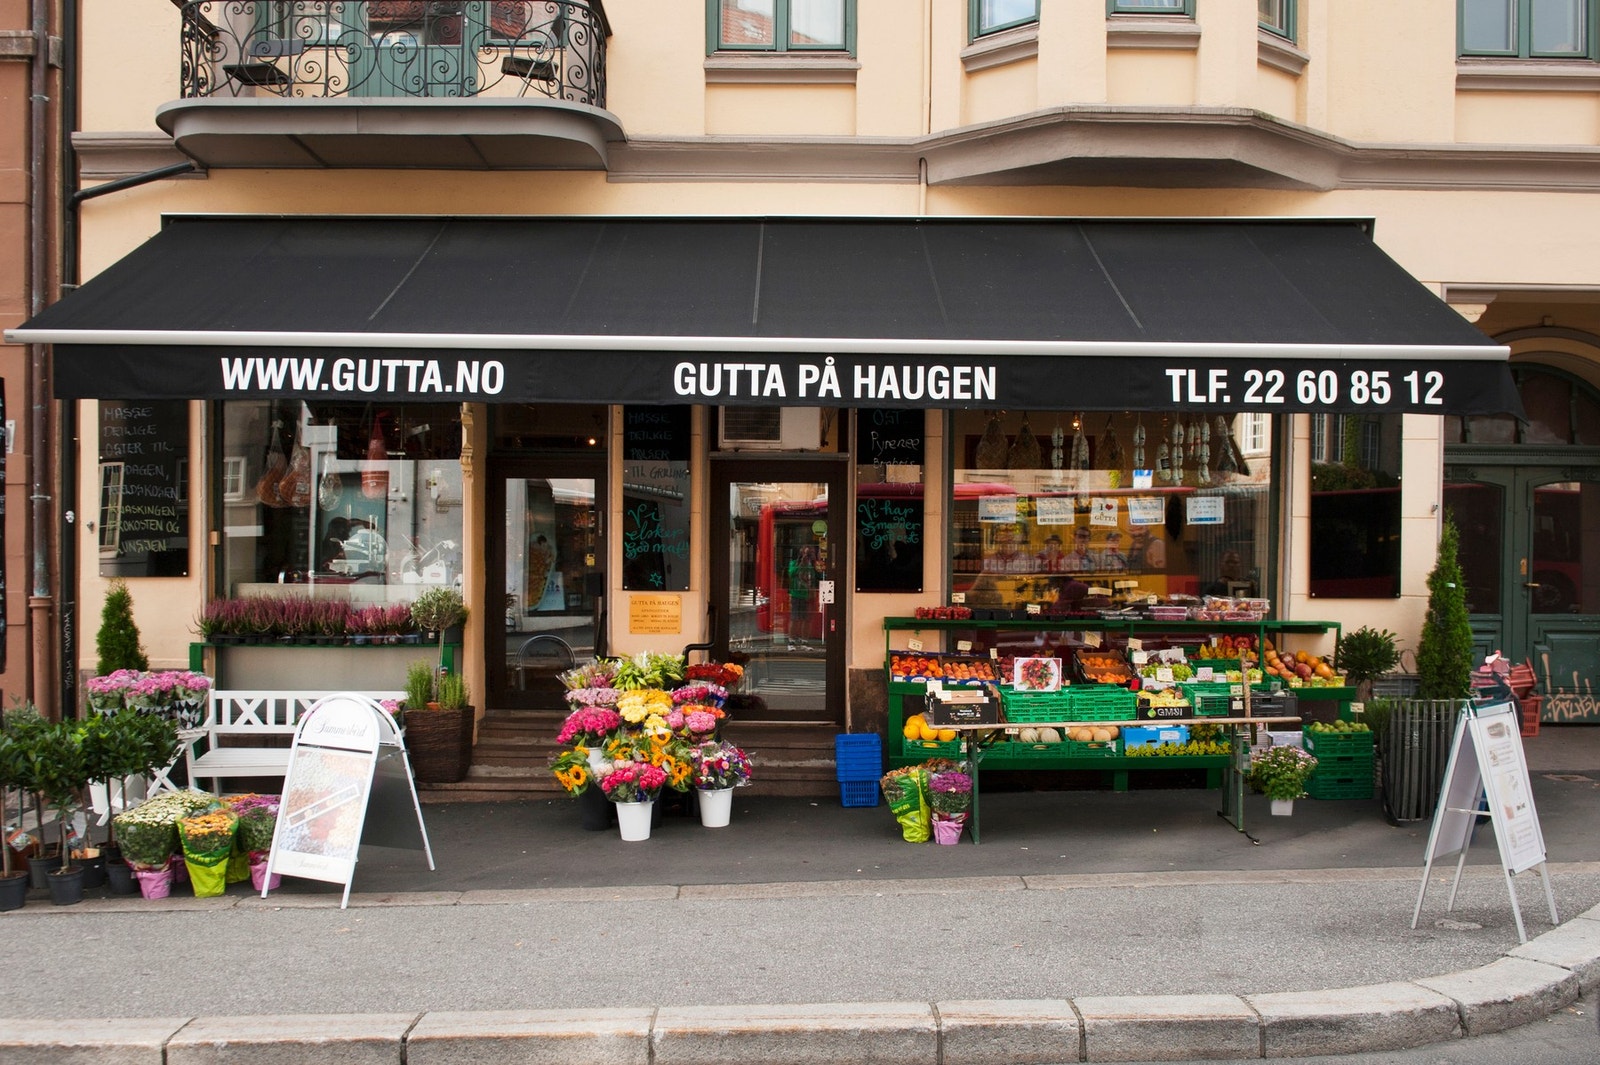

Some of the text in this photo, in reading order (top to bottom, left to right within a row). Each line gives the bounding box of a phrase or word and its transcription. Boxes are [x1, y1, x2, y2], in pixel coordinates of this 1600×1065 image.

[221, 357, 505, 395] WWW.GUTTA.NO
[673, 356, 997, 400] GUTTA PÅ HAUGEN
[1165, 368, 1444, 405] TLF. 22 60 85 12
[104, 406, 153, 421] MASSE
[628, 412, 671, 425] MASSE
[103, 424, 157, 438] DEILIGE
[105, 441, 174, 456] OSTER TIL
[106, 463, 170, 481] MIDAGEN,
[629, 465, 648, 478] TIL
[627, 503, 665, 528] Vi
[858, 498, 914, 521] Vi har
[165, 520, 181, 534] OG
[625, 521, 684, 541] elsker
